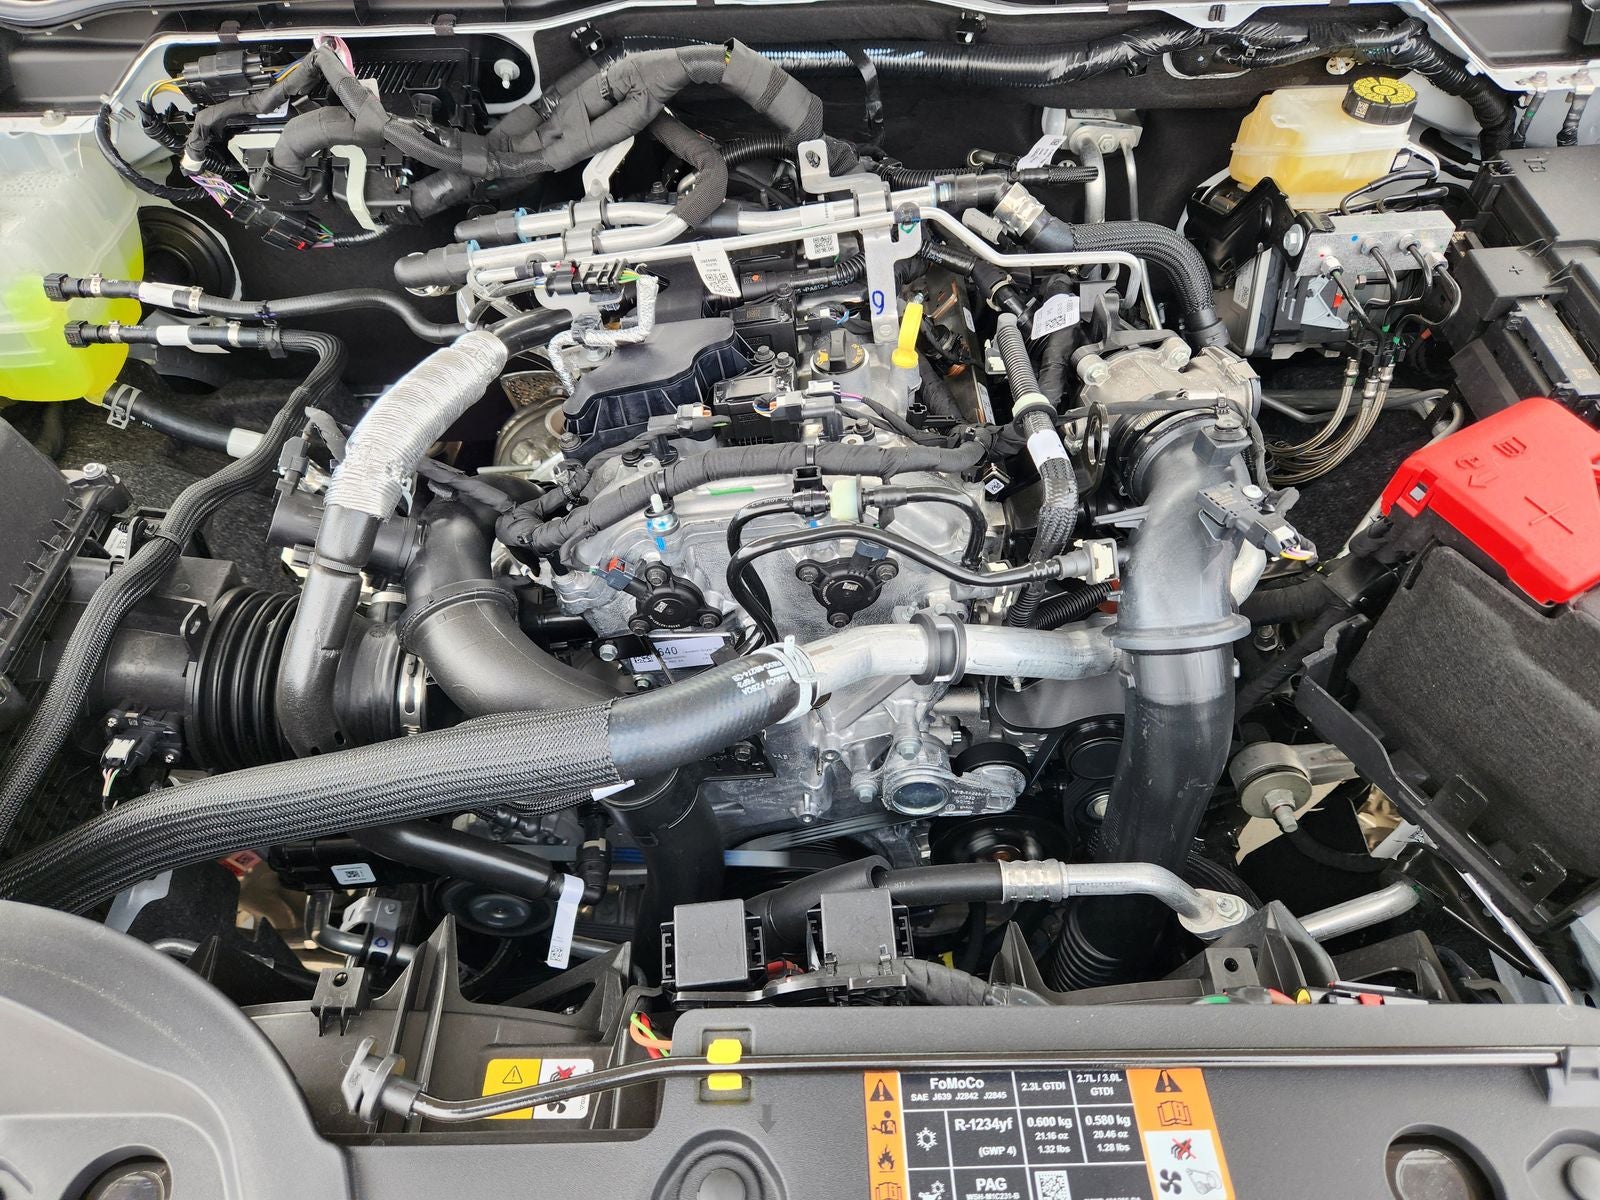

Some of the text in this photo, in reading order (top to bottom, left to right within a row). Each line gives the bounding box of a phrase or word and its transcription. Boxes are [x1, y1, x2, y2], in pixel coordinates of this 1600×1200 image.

[929, 1076, 985, 1090] FoMoCo
[1076, 1074, 1096, 1083] 2.7L
[1021, 1081, 1066, 1091] 2.3L GTDI
[910, 1091, 1007, 1101] SAE J639 J2842 J2845
[1090, 1087, 1114, 1096] GTDI
[954, 1116, 1013, 1133] R-1234yf
[1026, 1116, 1073, 1128] 0.600 kg
[1085, 1114, 1131, 1127] 0.580 kg
[1057, 1132, 1069, 1140] oz
[1117, 1130, 1129, 1138] oz
[978, 1145, 1017, 1158] (GWP 4)
[1037, 1144, 1071, 1153] 1.32 lbs
[1115, 1143, 1130, 1151] lbs
[975, 1177, 1008, 1191] PAG
